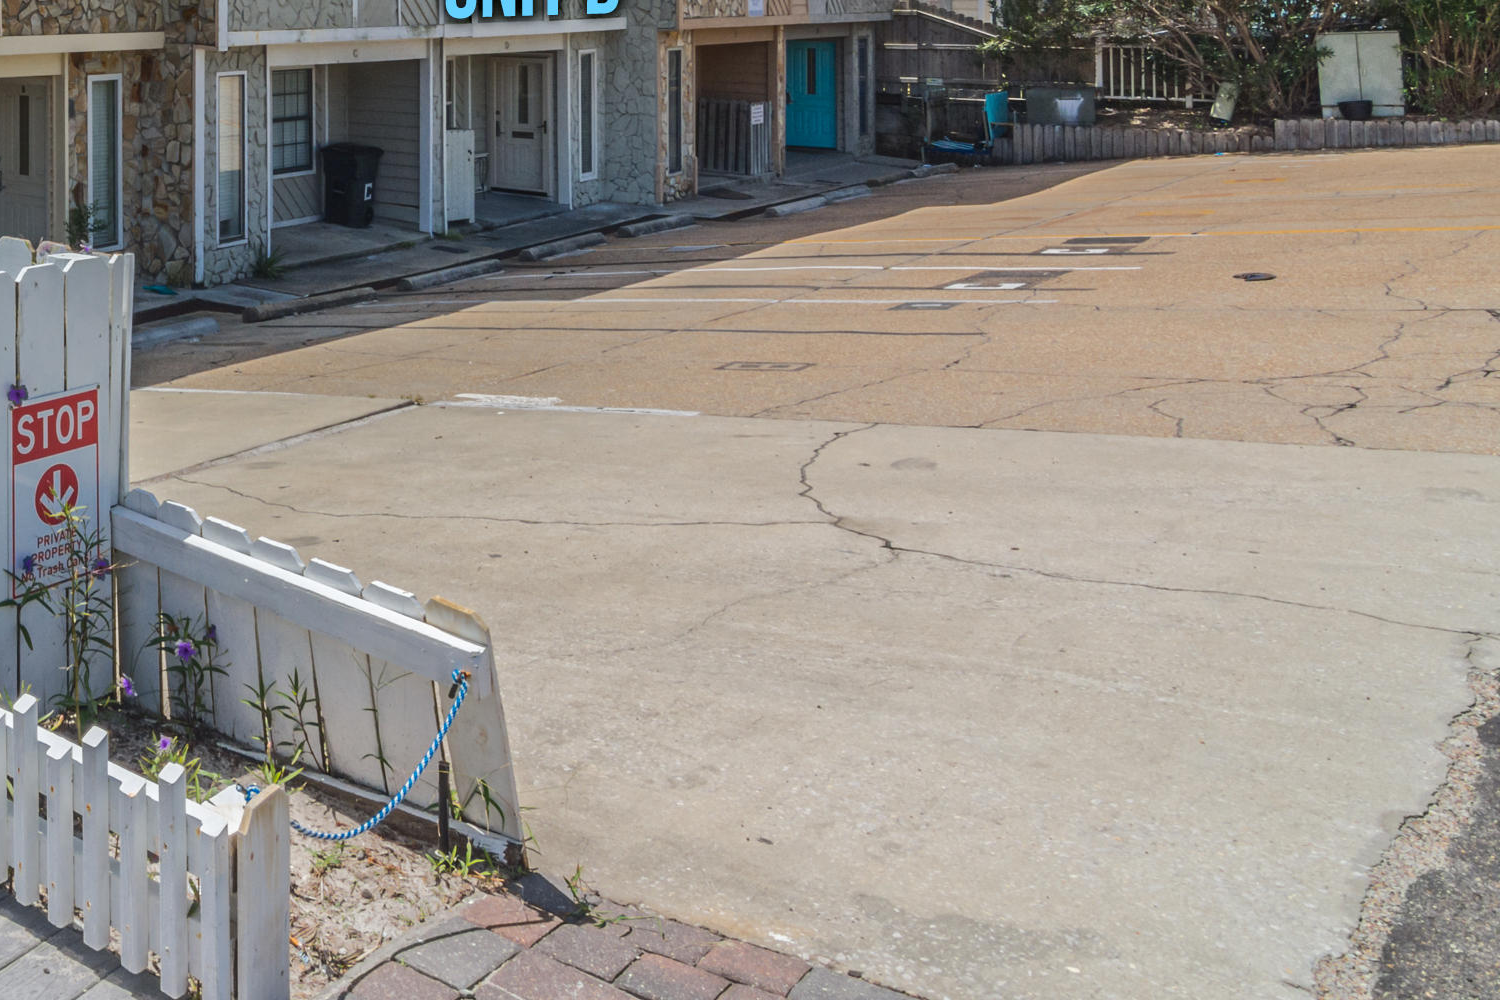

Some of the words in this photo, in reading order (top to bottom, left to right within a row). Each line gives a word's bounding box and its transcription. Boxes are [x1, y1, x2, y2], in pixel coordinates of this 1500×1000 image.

[364, 183, 373, 201] C
[16, 399, 95, 455] STOP
[37, 528, 77, 548] PRIVATE
[31, 540, 82, 562] PROPERTY
[37, 561, 64, 578] Trash
